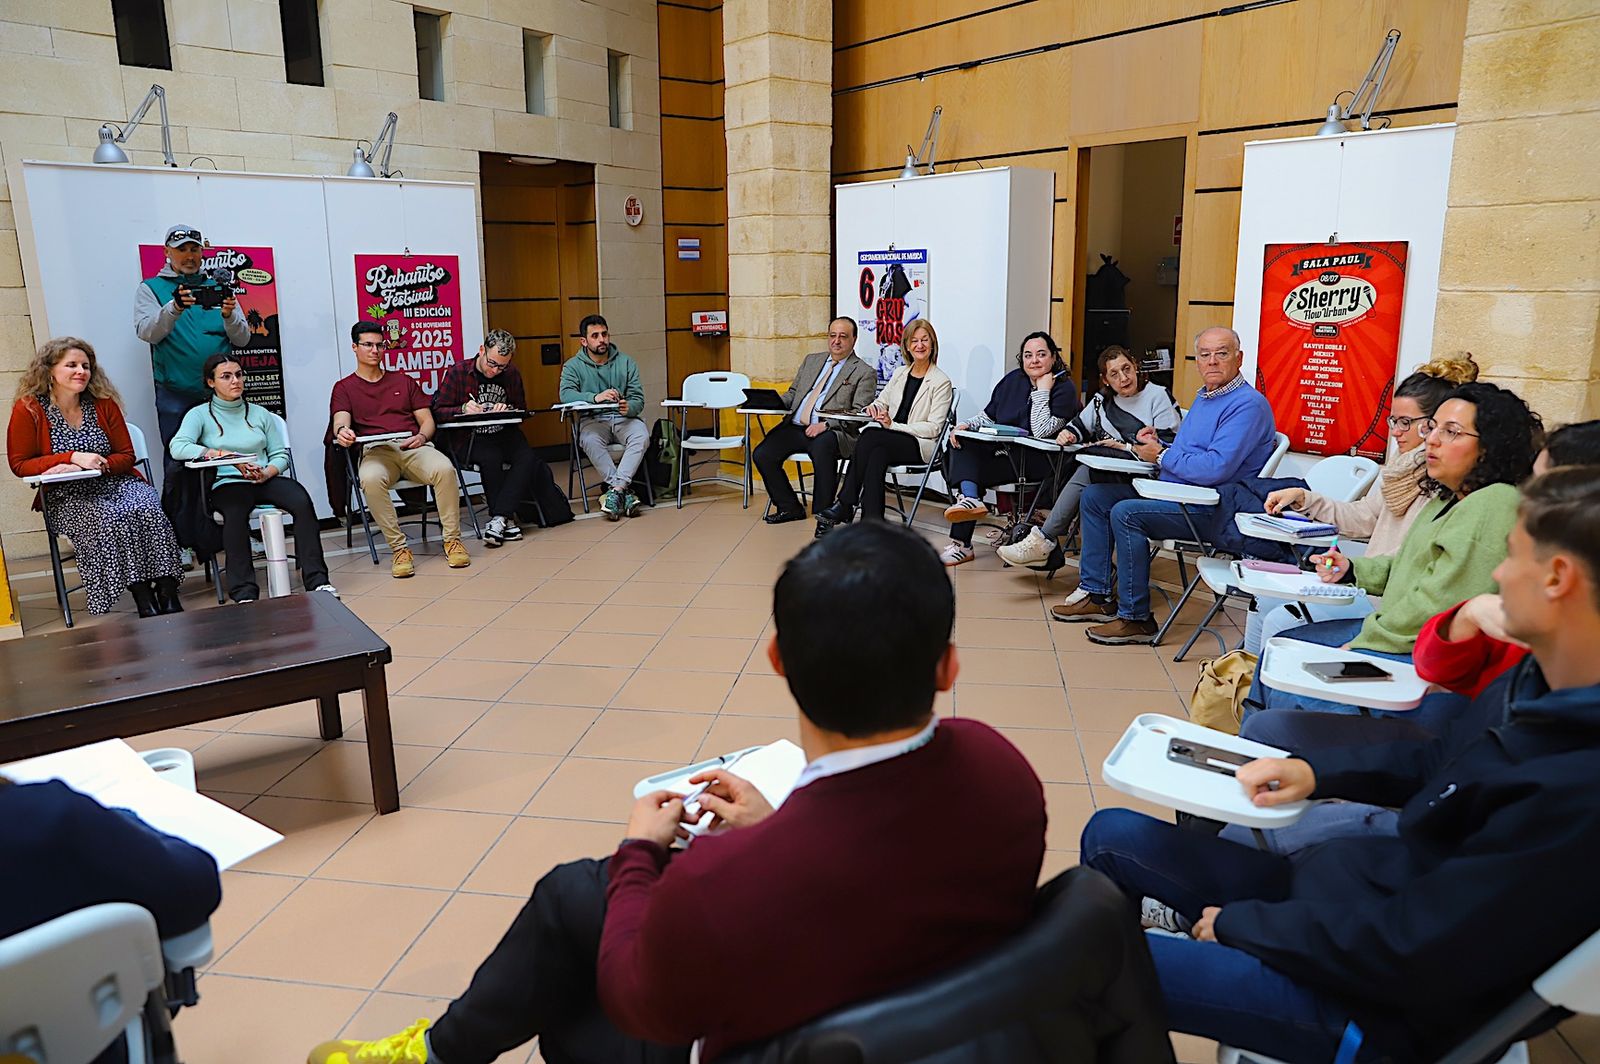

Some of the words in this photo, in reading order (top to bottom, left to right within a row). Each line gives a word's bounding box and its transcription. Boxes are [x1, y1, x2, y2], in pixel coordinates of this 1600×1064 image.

[201, 249, 246, 270] anito
[1303, 258, 1329, 268] SALA
[1332, 254, 1360, 266] PAUL
[365, 263, 445, 292] Rabanito
[858, 266, 876, 309] 6
[1320, 274, 1339, 282] 08/07
[380, 285, 434, 310] Festival
[1297, 286, 1361, 312] Sherry
[404, 308, 412, 317] III
[414, 305, 451, 317] EDICIÓN
[876, 298, 904, 322] GRU
[1304, 309, 1322, 320] Flow
[1322, 306, 1347, 317] Urban
[412, 329, 453, 348] 2025
